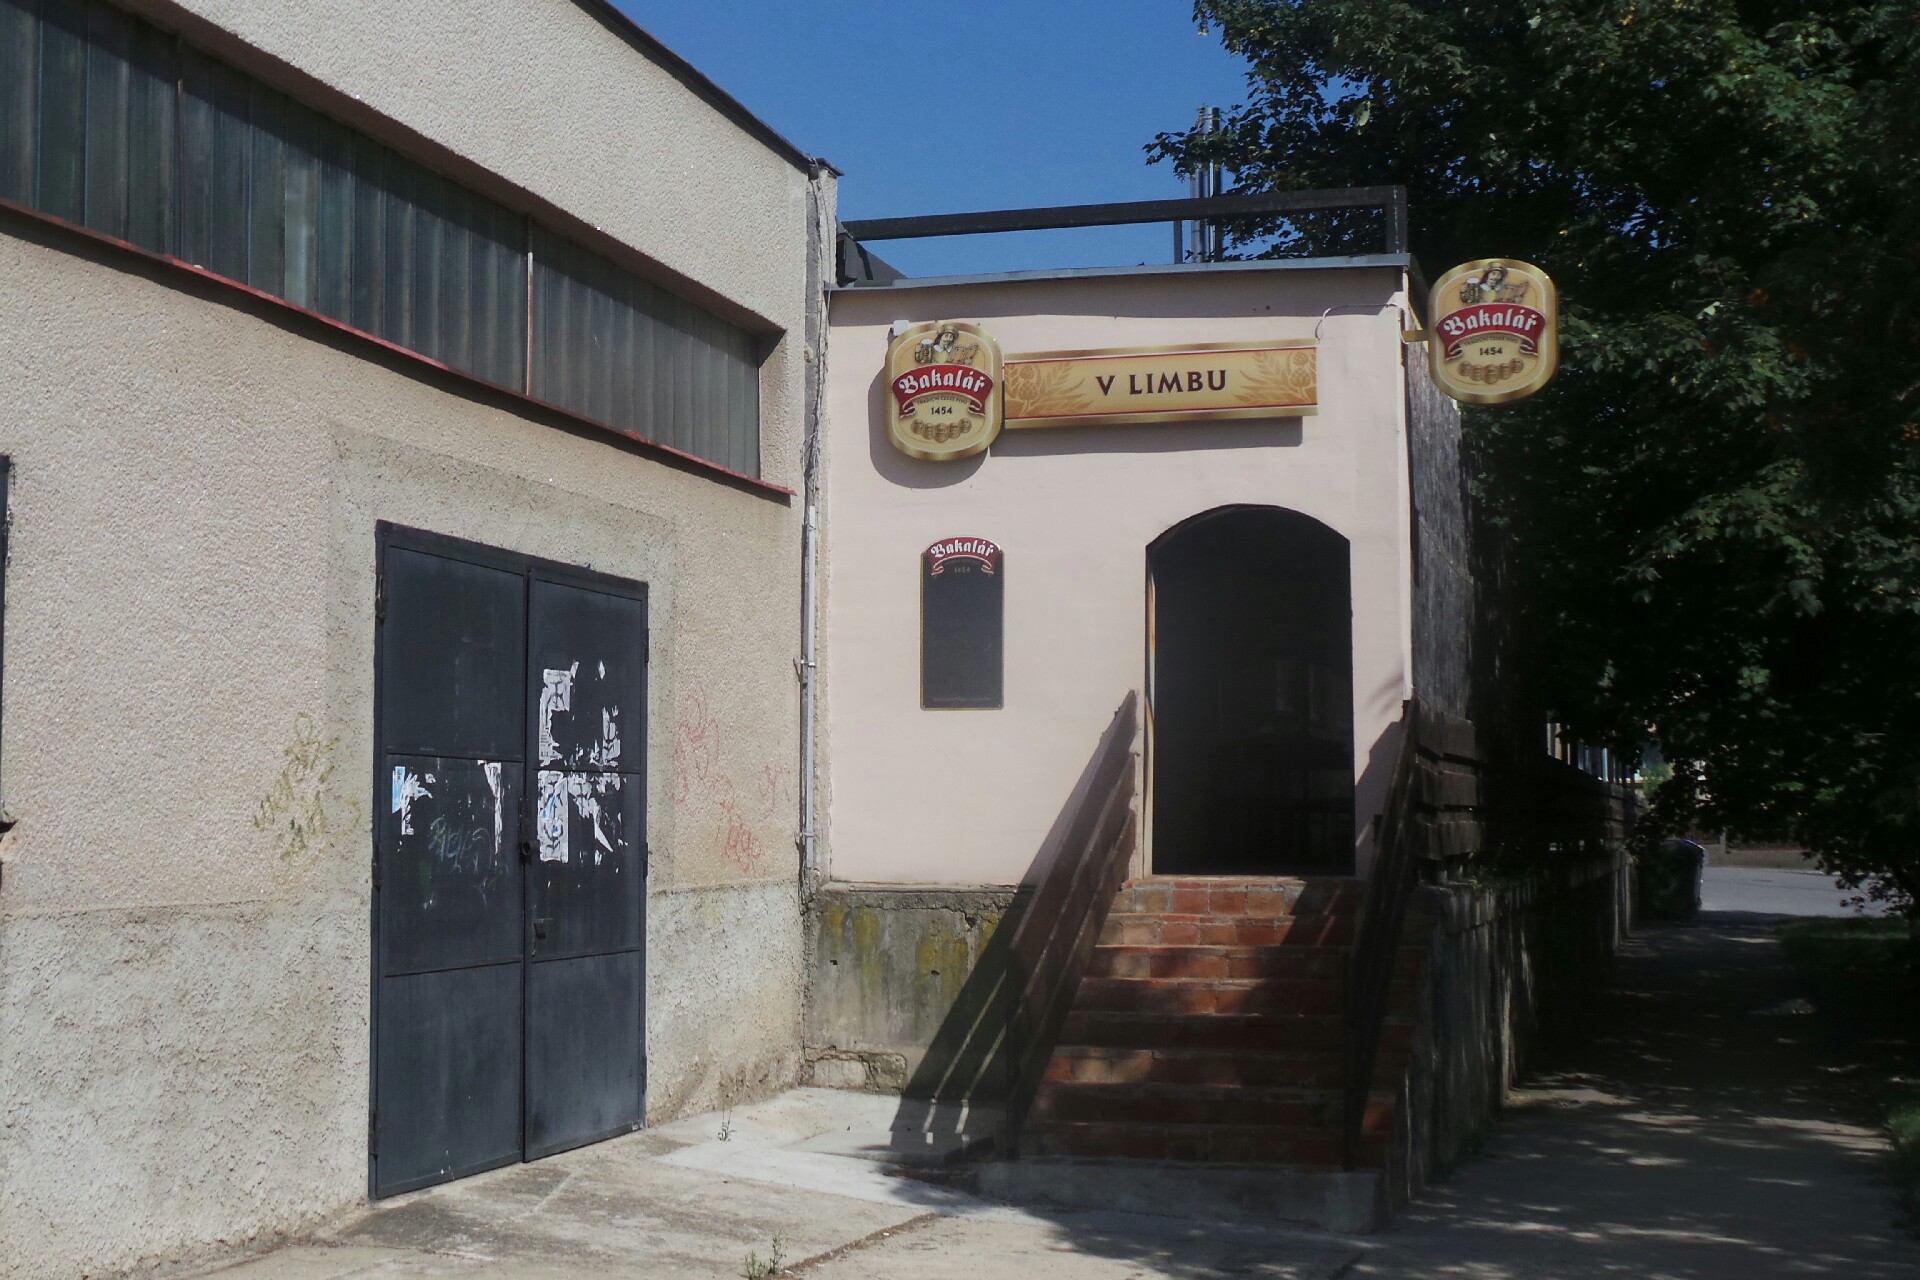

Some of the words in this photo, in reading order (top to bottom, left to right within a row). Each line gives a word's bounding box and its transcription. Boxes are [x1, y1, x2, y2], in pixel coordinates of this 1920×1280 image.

[1443, 308, 1537, 335] Bakalář
[1479, 346, 1503, 356] 1454
[898, 368, 986, 394] Bakalář
[1095, 375, 1116, 396] V
[1128, 369, 1227, 395] LIMBU
[931, 406, 953, 415] 1454
[930, 539, 994, 558] Bakalář
